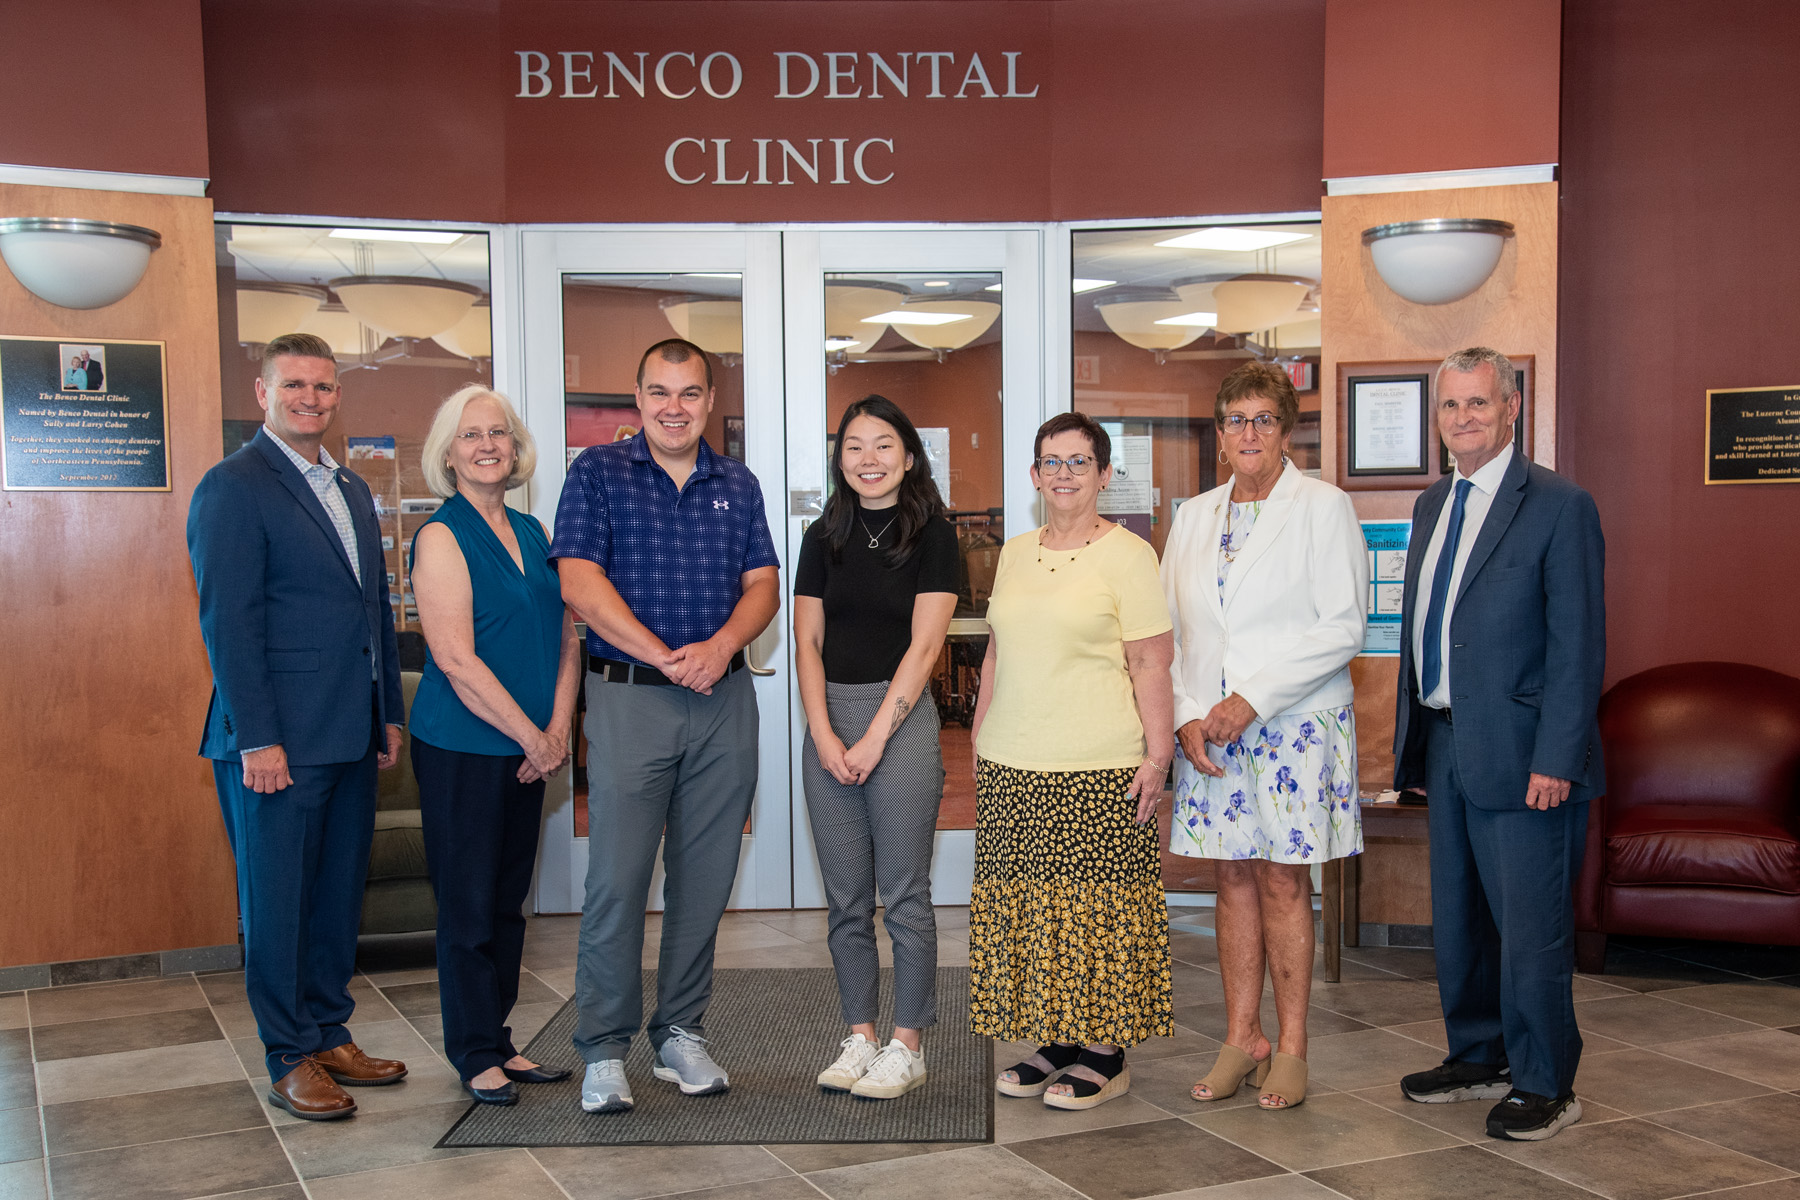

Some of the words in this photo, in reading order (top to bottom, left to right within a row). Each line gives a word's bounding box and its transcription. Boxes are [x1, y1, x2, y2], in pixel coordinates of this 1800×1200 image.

[514, 50, 743, 100] BENCO
[773, 51, 1040, 99] DENTAL
[664, 137, 896, 186] CLINIC
[128, 437, 160, 446] dentistry
[1745, 434, 1784, 443] recognition
[1748, 443, 1773, 452] provide
